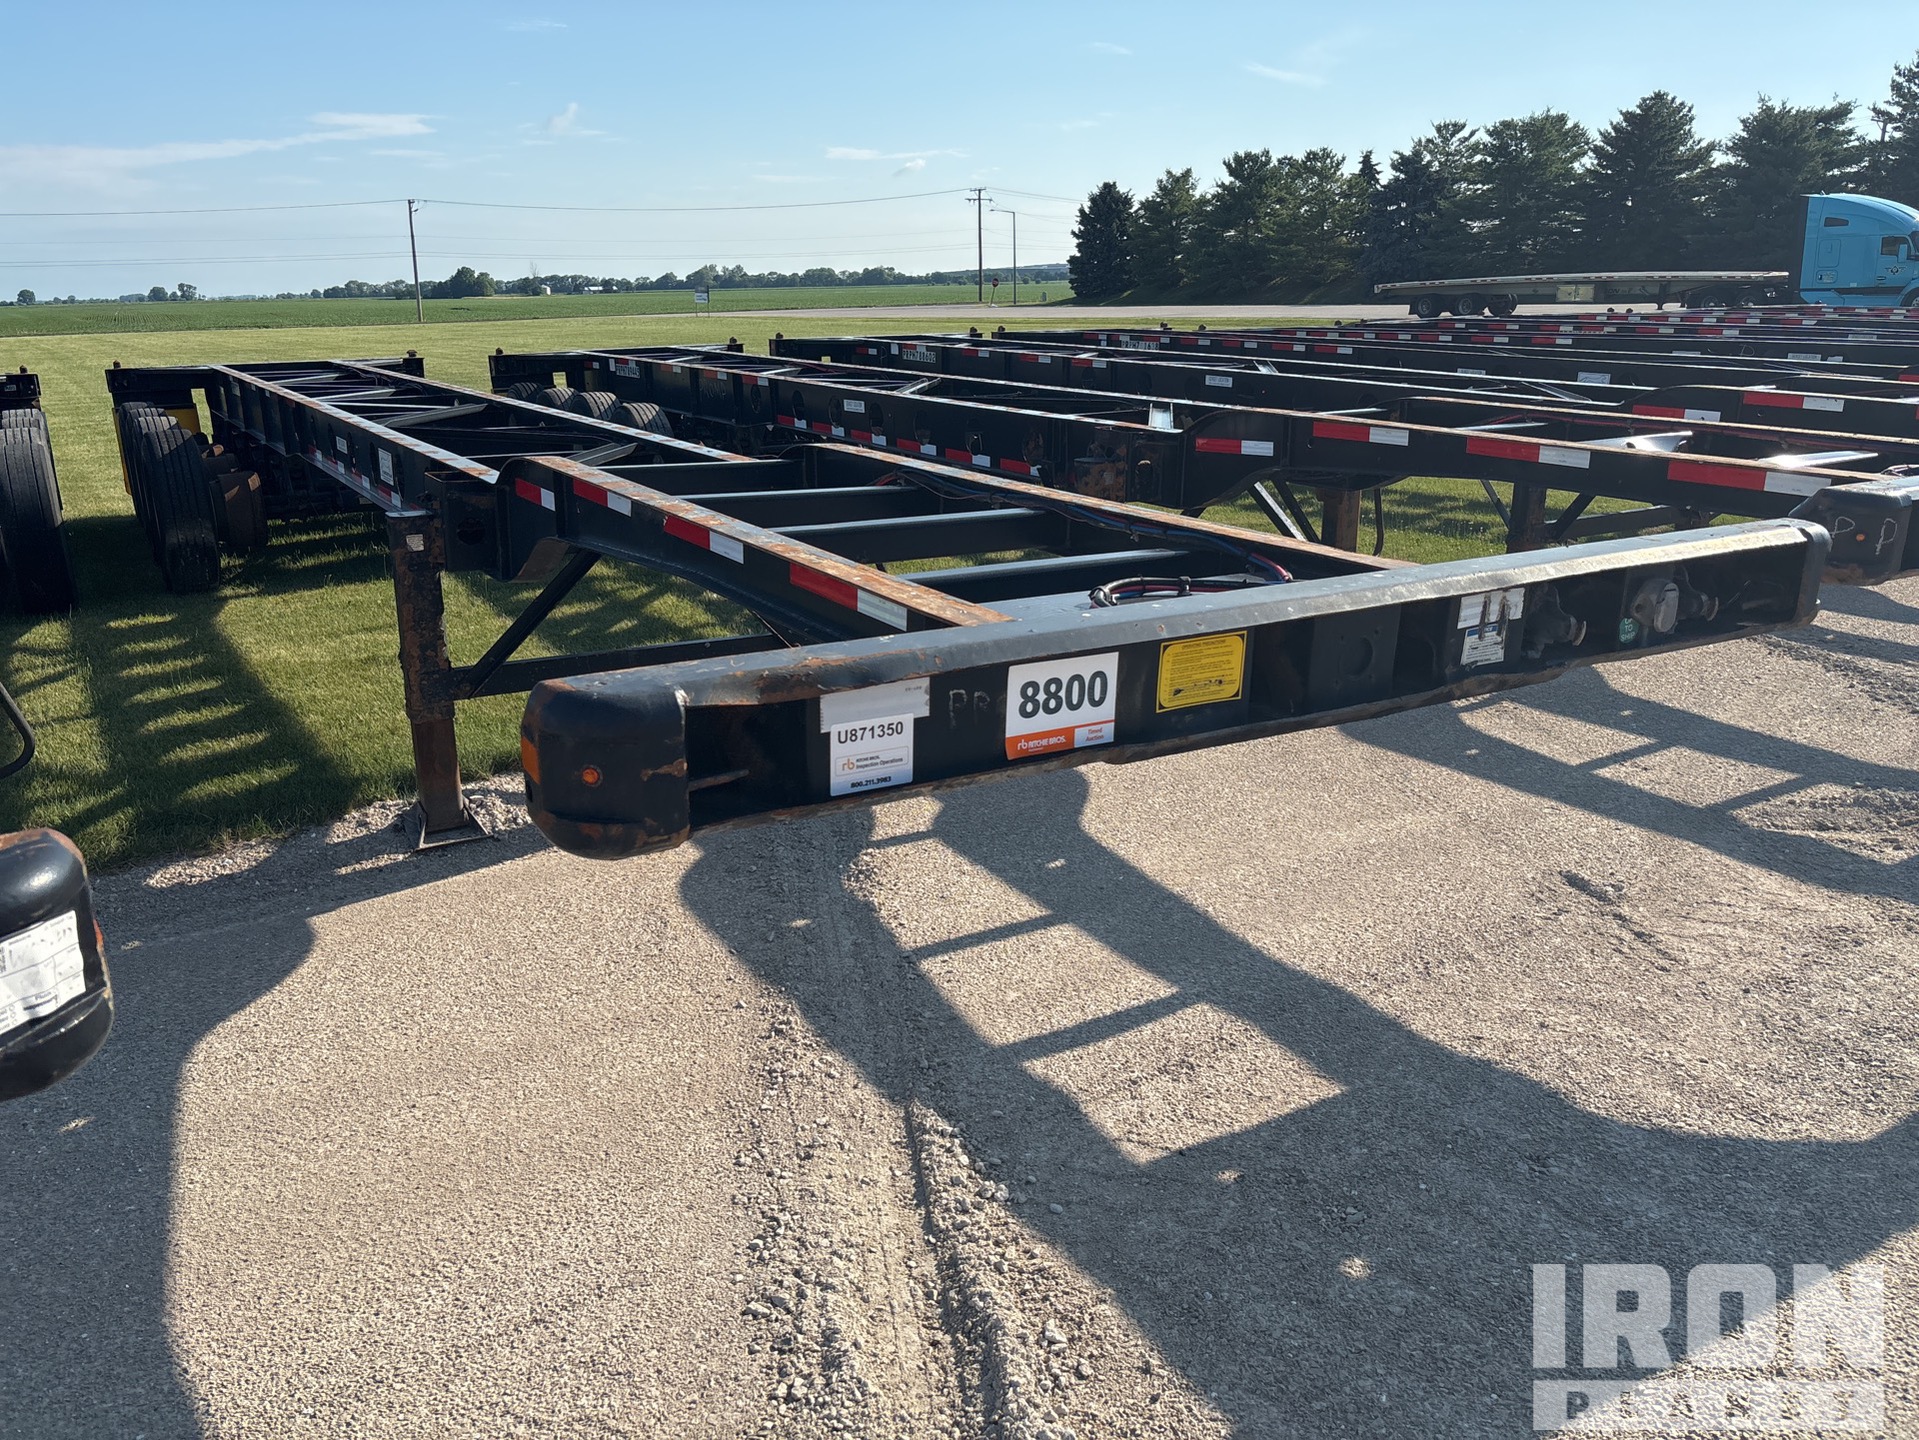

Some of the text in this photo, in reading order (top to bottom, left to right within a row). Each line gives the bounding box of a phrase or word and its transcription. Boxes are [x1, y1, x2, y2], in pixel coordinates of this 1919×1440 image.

[1018, 670, 1108, 719] 8800
[837, 721, 904, 744] U871350
[1017, 738, 1028, 751] rb
[842, 758, 855, 771] rb
[856, 757, 904, 770] Inspection Operations
